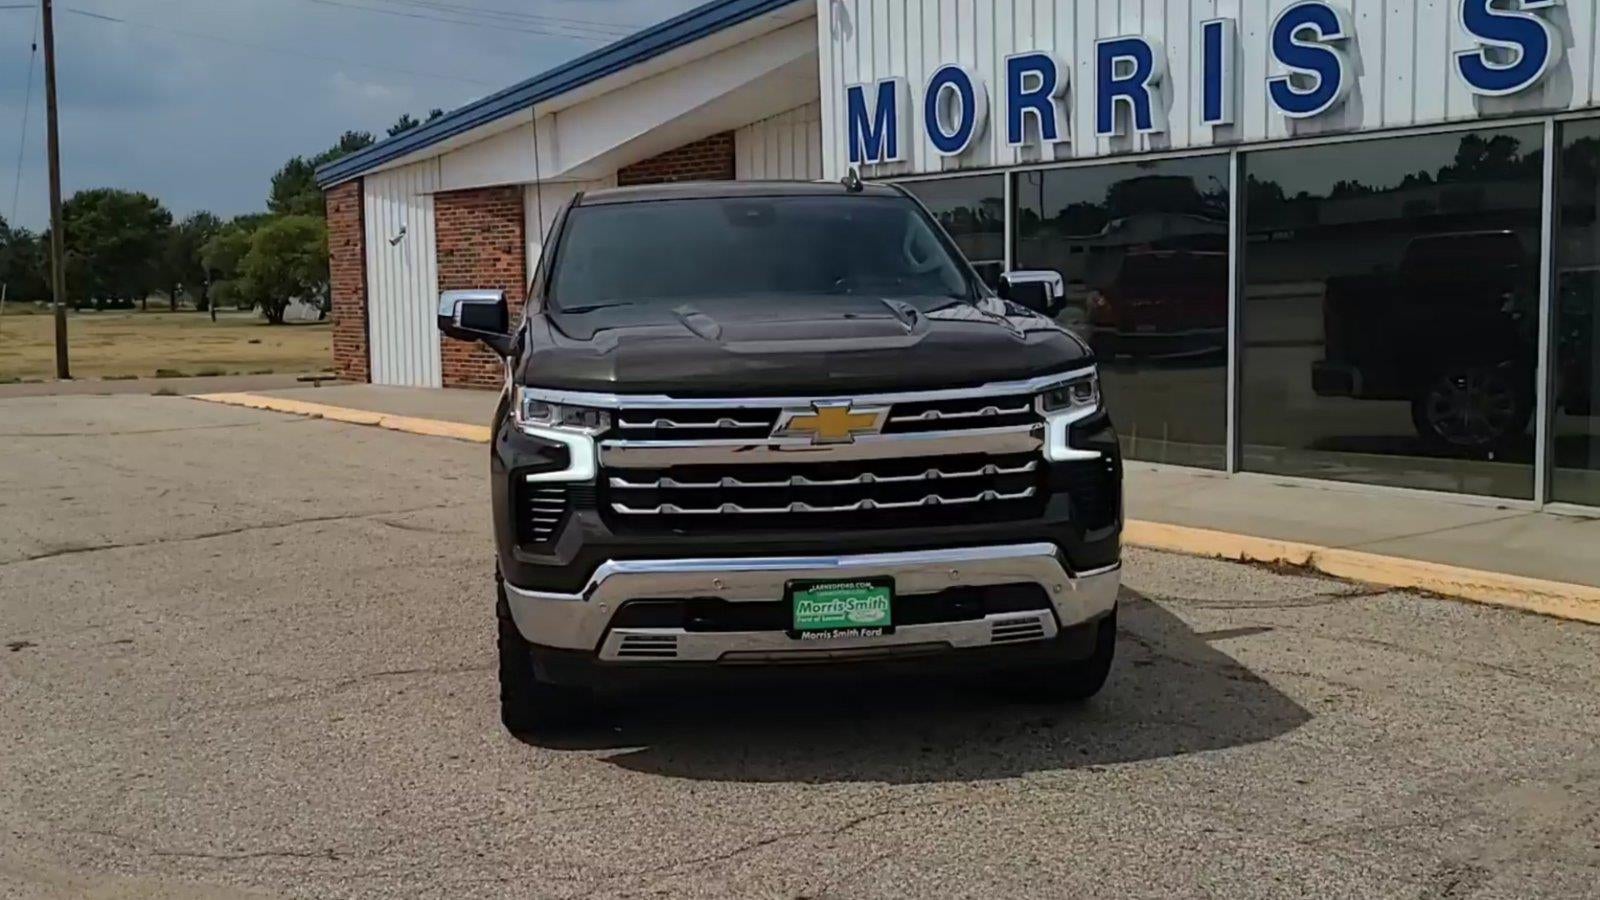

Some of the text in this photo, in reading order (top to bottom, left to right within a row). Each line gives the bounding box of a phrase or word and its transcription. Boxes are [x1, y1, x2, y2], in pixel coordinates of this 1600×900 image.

[846, 0, 1346, 165] MORRIS
[798, 599, 844, 614] Morris
[845, 596, 887, 611] Smith
[802, 628, 882, 640] Morris Smith Ford
